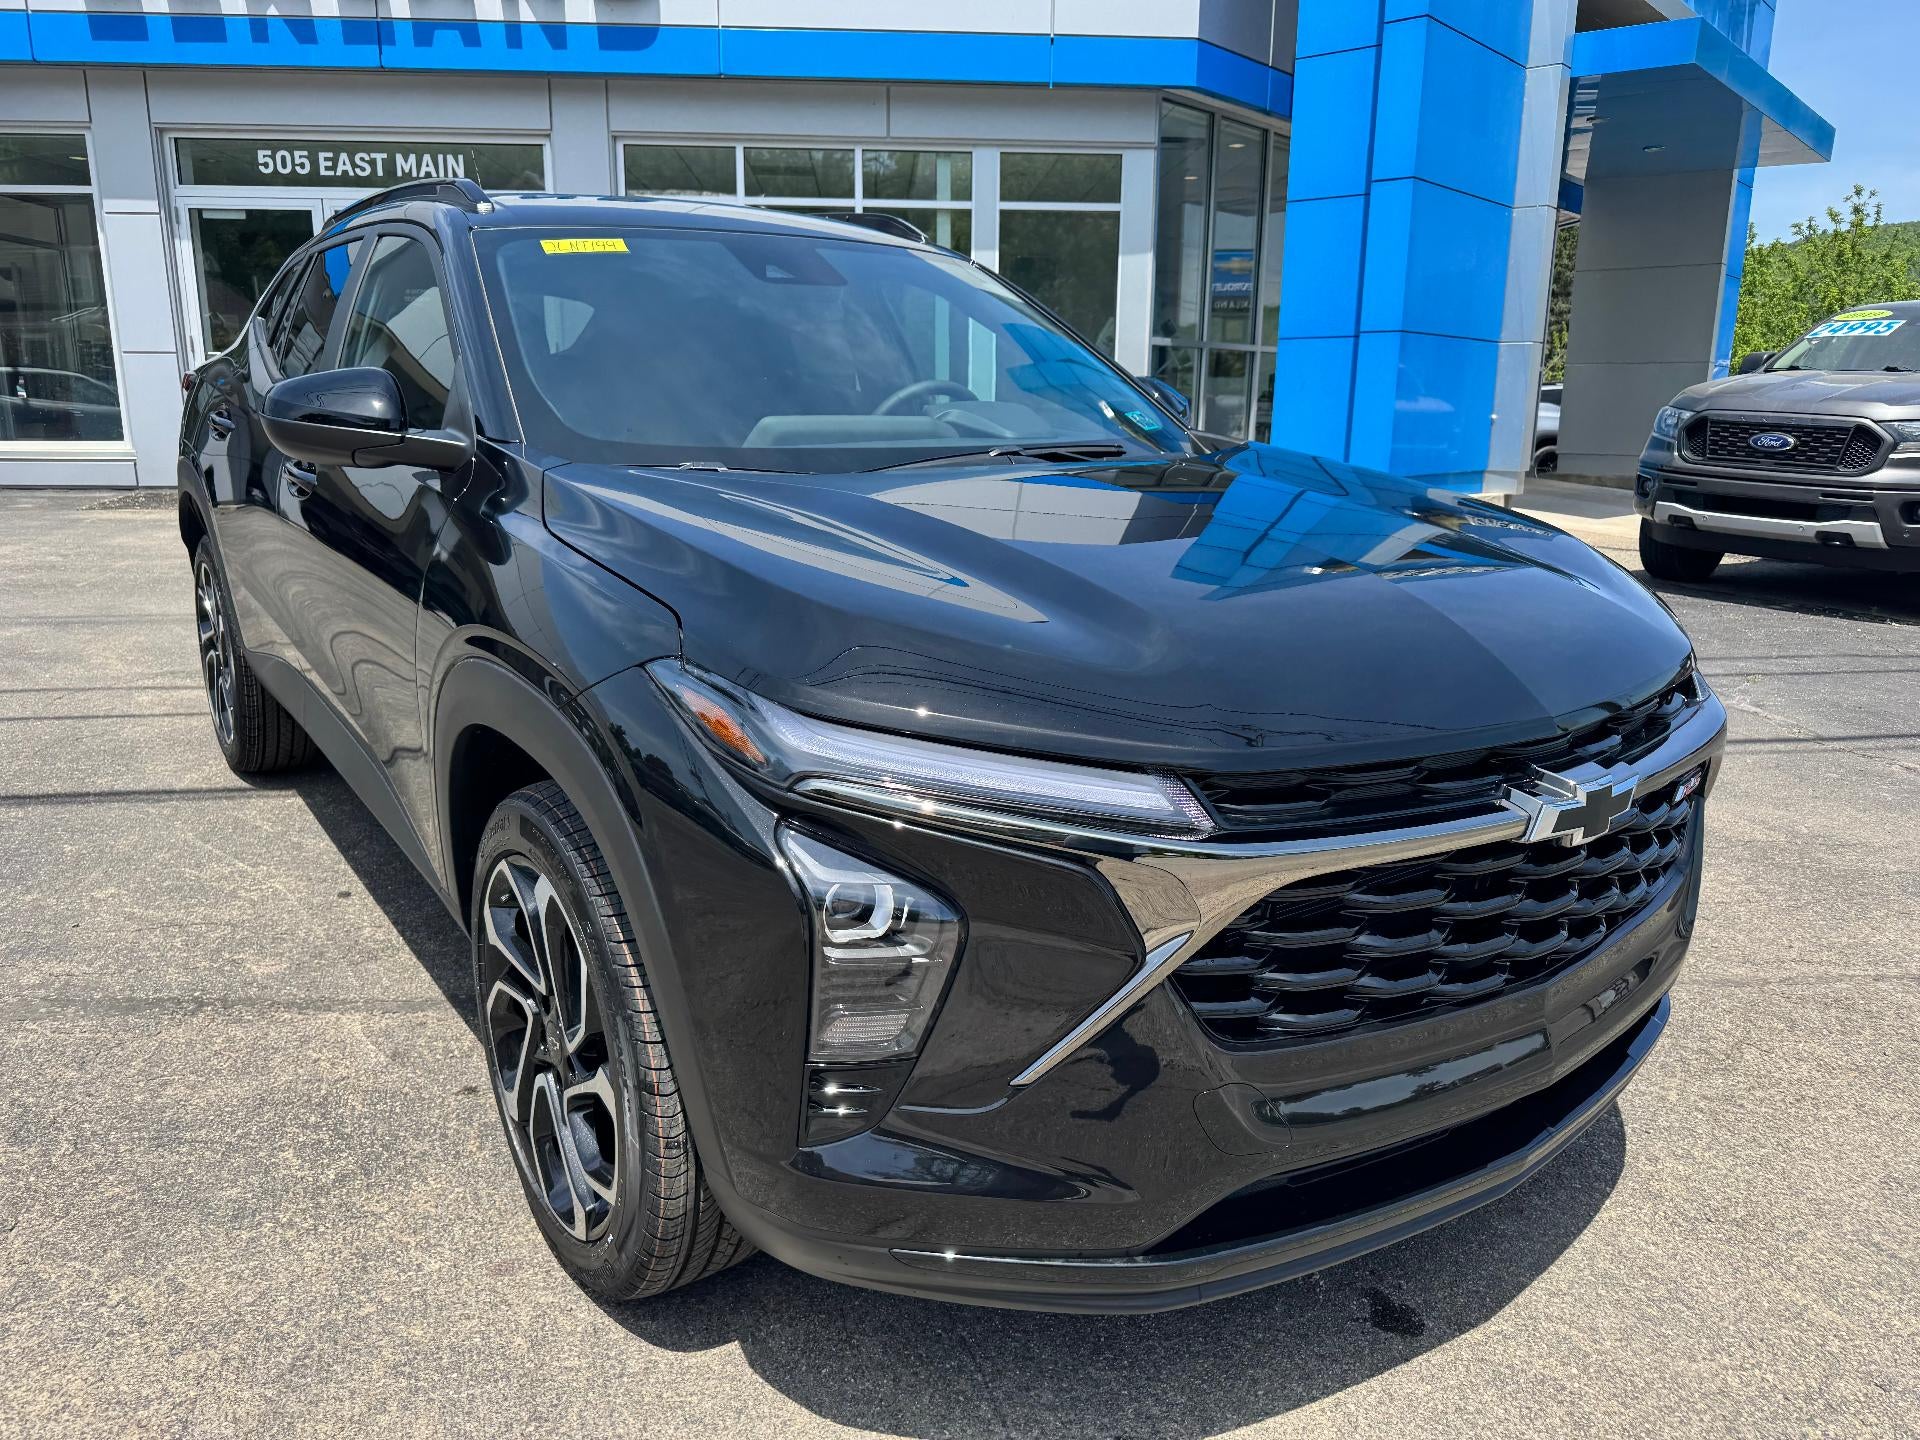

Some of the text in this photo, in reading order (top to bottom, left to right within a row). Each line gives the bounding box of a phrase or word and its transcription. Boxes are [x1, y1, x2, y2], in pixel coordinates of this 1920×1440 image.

[257, 150, 465, 178] 505 EAST MAIN
[1809, 321, 1901, 337] 24995
[1757, 436, 1783, 447] Ford
